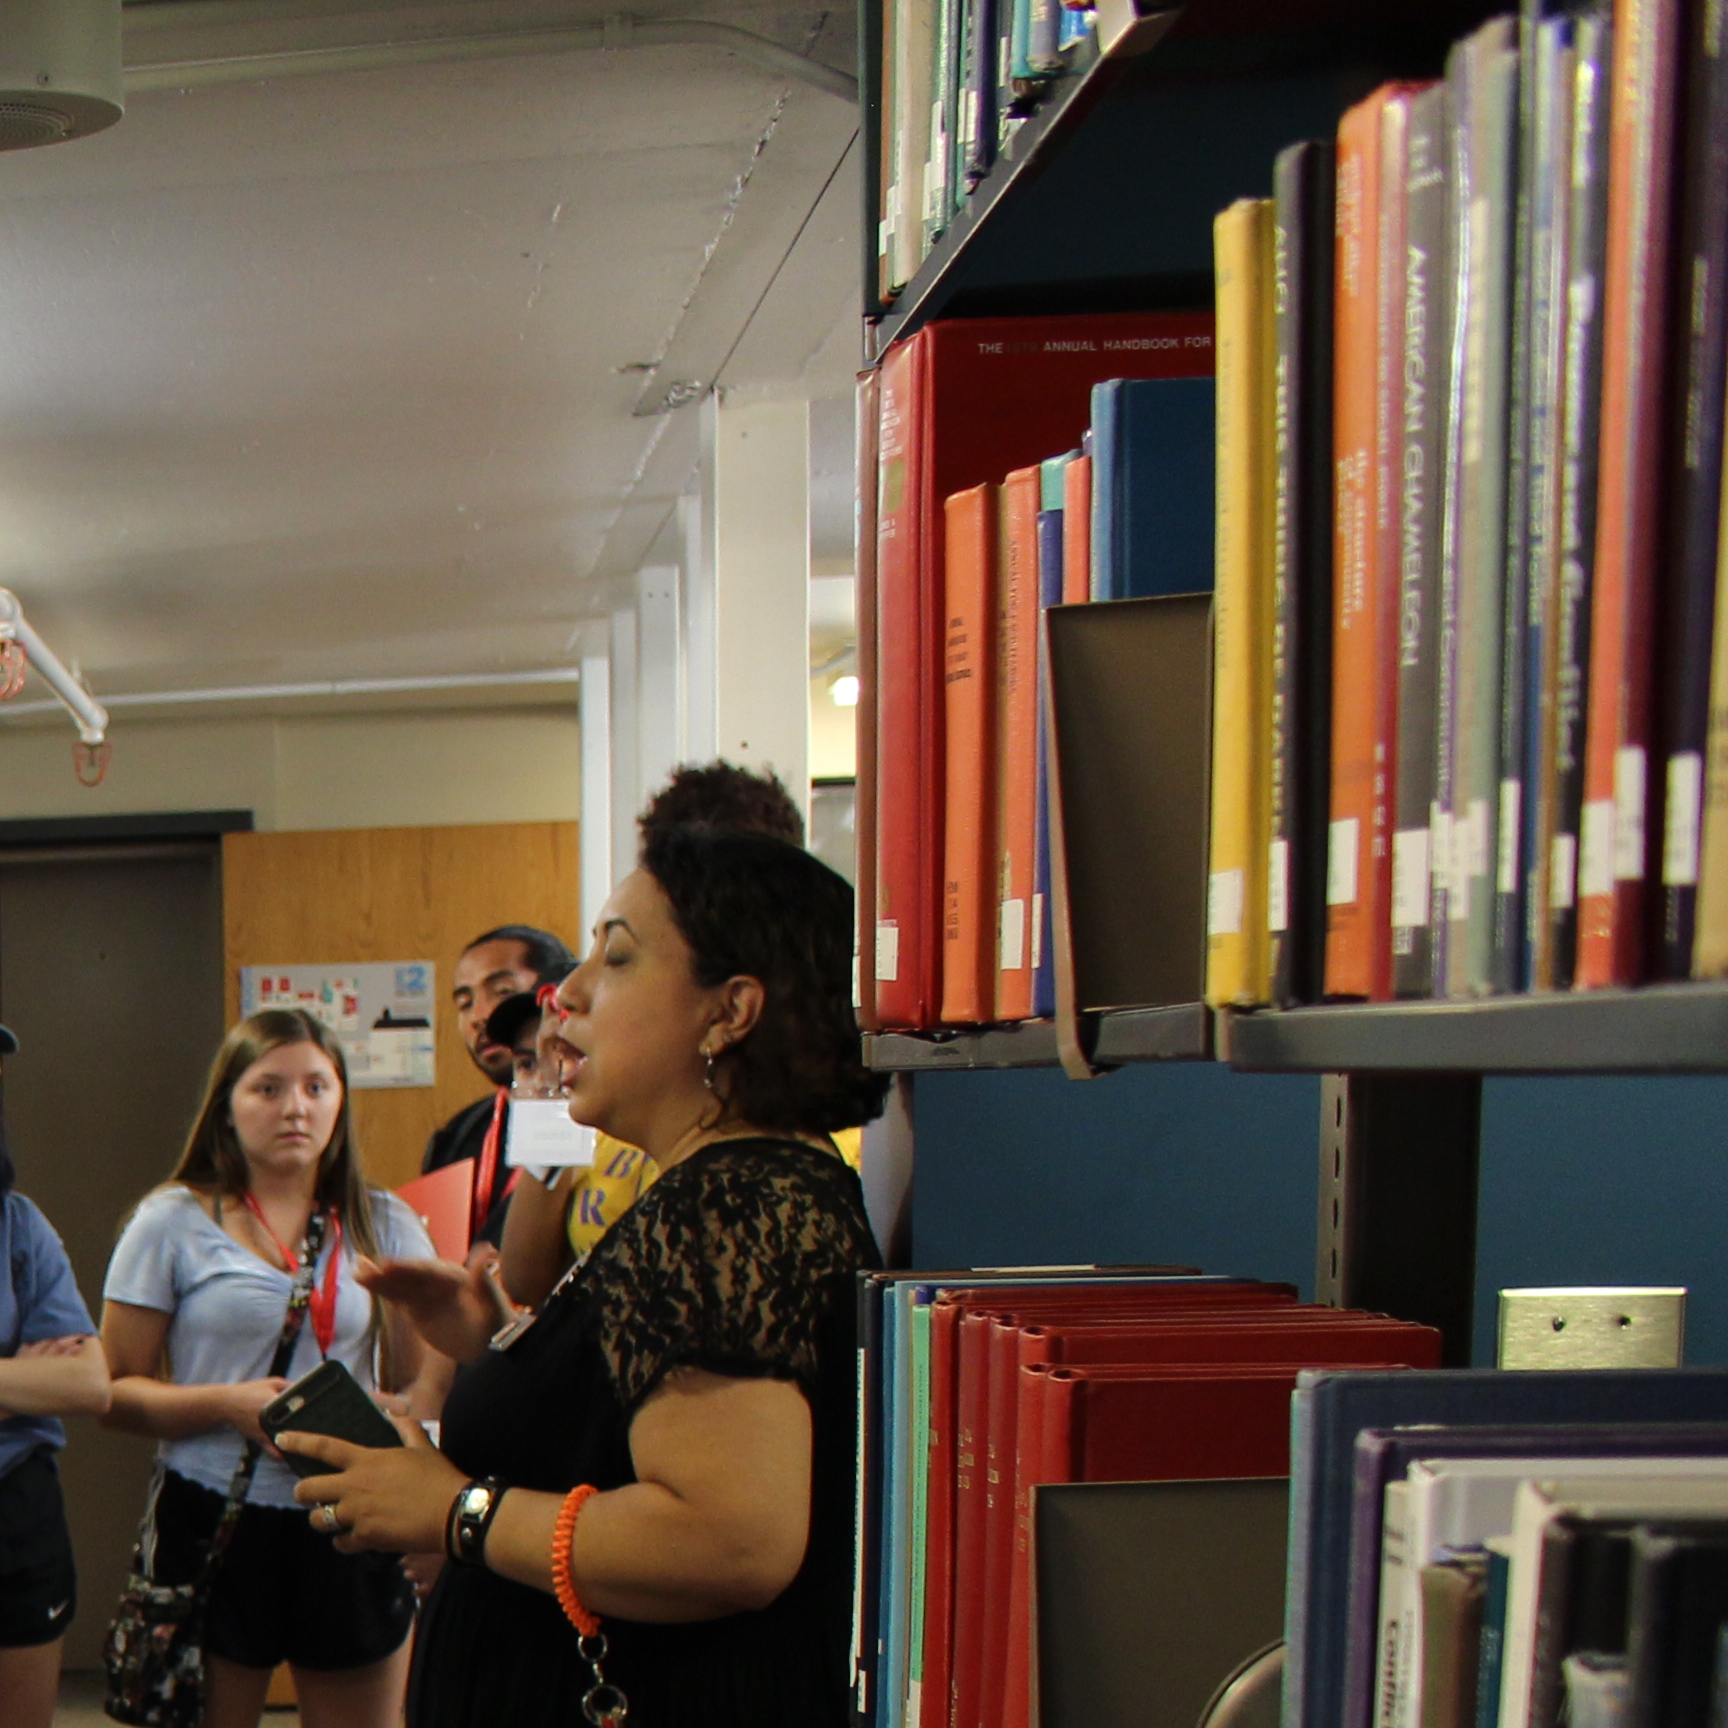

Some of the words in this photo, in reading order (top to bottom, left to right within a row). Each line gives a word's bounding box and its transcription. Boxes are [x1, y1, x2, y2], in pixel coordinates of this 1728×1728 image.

[977, 343, 1004, 355] THE
[1042, 340, 1097, 353] ANNUAL
[1102, 338, 1180, 351] HANDBOOK
[1184, 336, 1212, 348] FOR
[1403, 244, 1429, 434] AMERICAN
[1400, 441, 1425, 668] CHAMELEON
